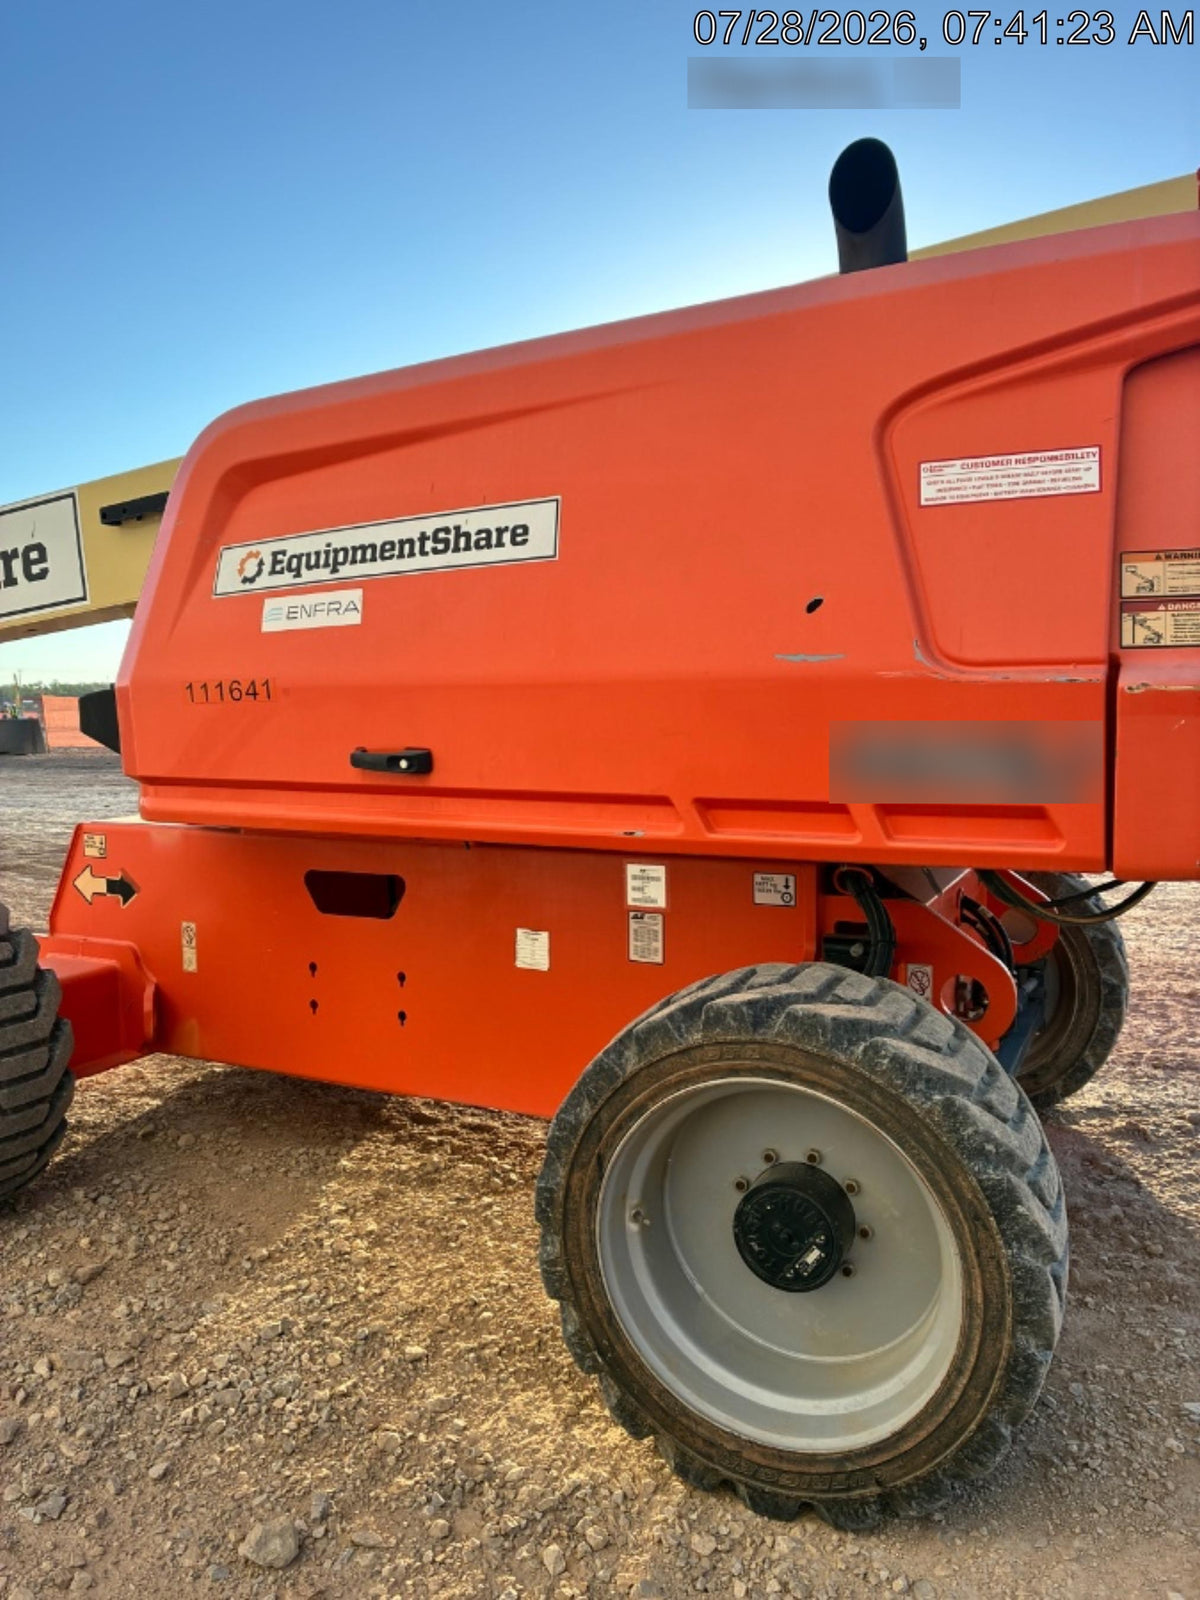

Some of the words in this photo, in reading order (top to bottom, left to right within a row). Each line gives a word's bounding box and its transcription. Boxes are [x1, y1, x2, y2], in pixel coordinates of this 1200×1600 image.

[960, 457, 1013, 470] CUSTOMER
[268, 522, 530, 579] EquipmentShare
[0, 541, 50, 590] re
[285, 599, 361, 621] ENFRA
[185, 678, 272, 703] 111641
